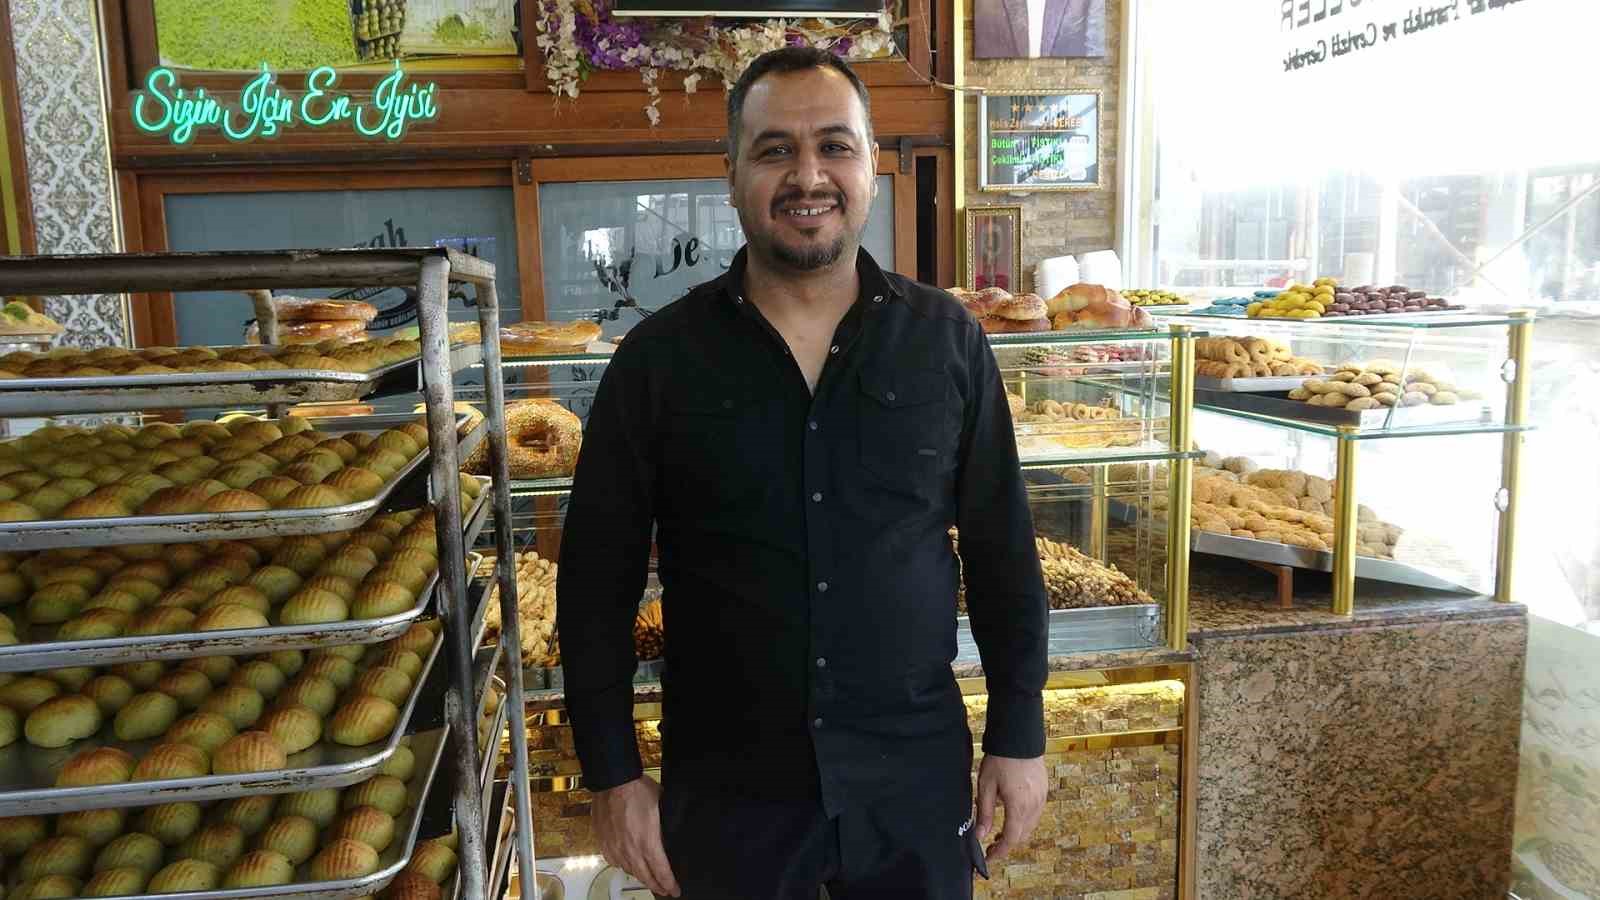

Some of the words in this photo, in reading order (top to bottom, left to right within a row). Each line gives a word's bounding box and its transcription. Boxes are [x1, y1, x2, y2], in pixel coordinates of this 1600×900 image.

[135, 67, 221, 145] Sizin
[223, 59, 294, 140] İçin
[301, 66, 352, 125] En
[354, 58, 438, 139] İyisi
